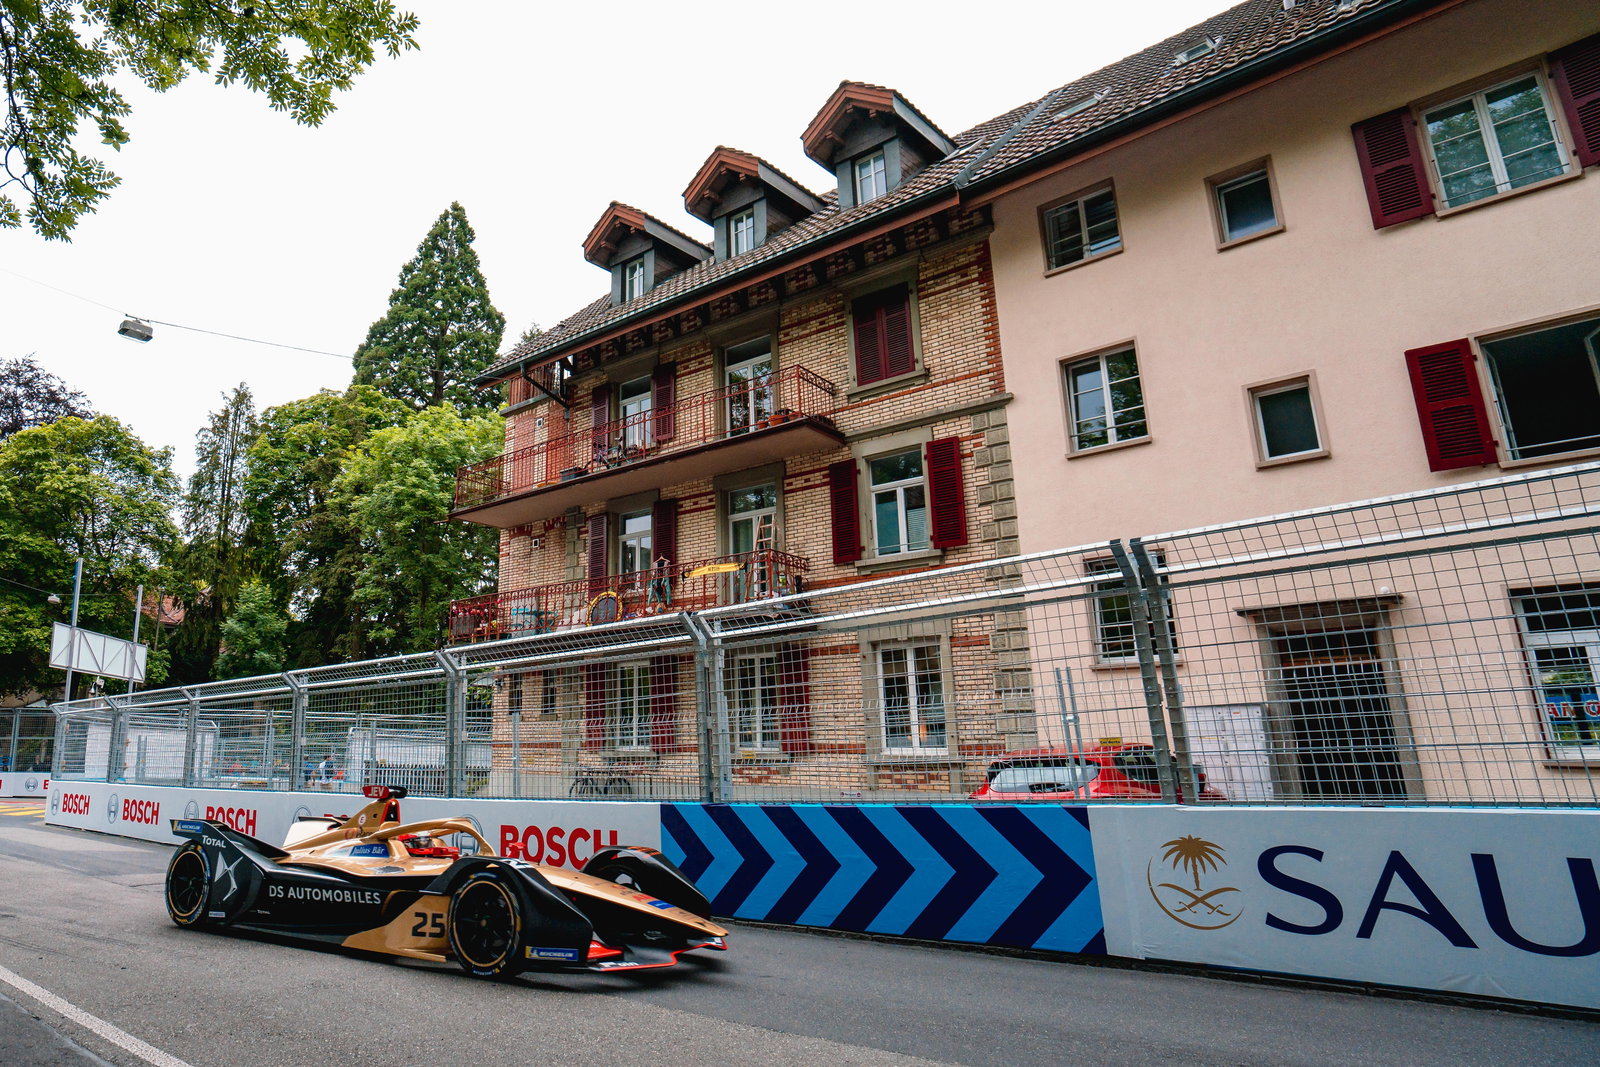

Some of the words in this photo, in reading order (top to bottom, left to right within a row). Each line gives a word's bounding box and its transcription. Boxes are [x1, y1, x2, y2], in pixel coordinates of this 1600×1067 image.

[368, 786, 384, 797] JEV
[62, 793, 91, 815] BOSCH
[122, 799, 160, 825] BOSCH
[206, 806, 257, 837] BOSCH
[202, 834, 226, 848] TOTAL
[269, 885, 284, 898] DS
[288, 887, 381, 904] AUTOMOBILES
[1257, 844, 1600, 957] SAU
[412, 912, 446, 939] 25
